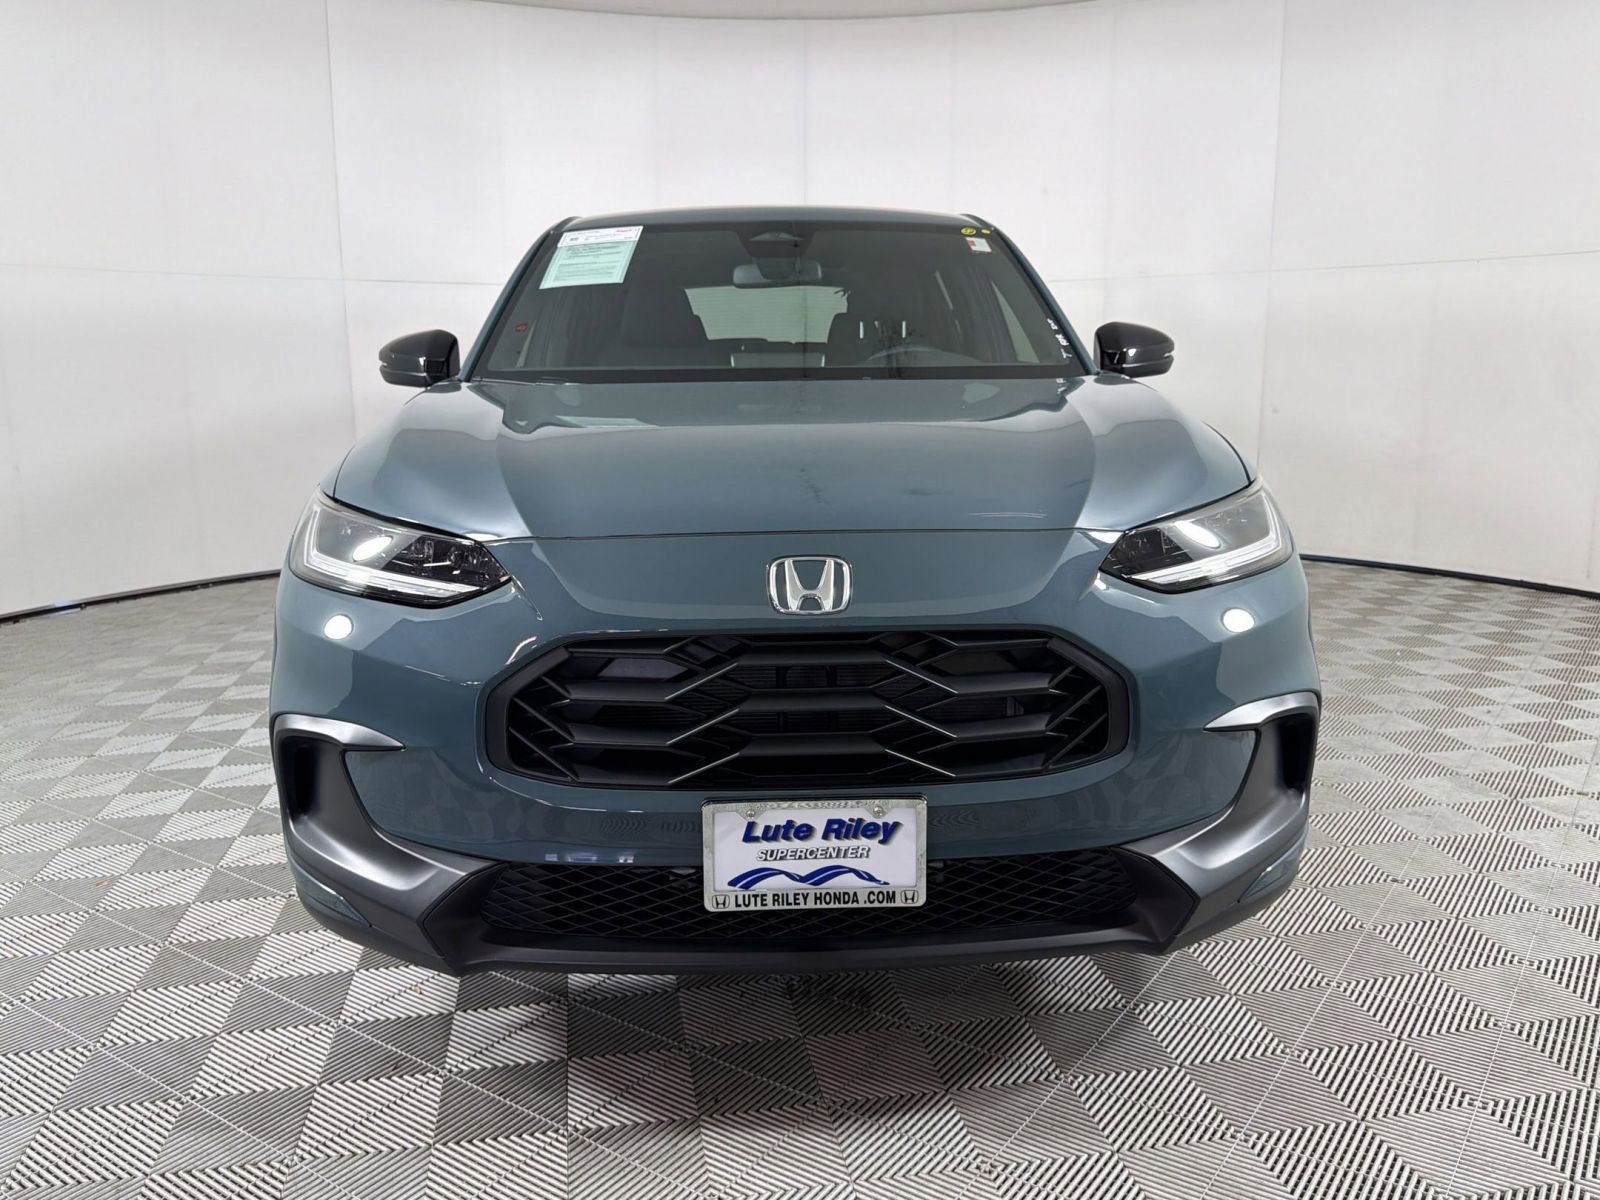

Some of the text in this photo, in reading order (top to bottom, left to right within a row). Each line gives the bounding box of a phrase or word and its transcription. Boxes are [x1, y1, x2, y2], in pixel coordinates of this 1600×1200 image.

[742, 817, 903, 845] Lute Riley
[756, 845, 871, 862] SUPERCENTER
[734, 890, 897, 908] LUTE RILEY HONDA .COM
